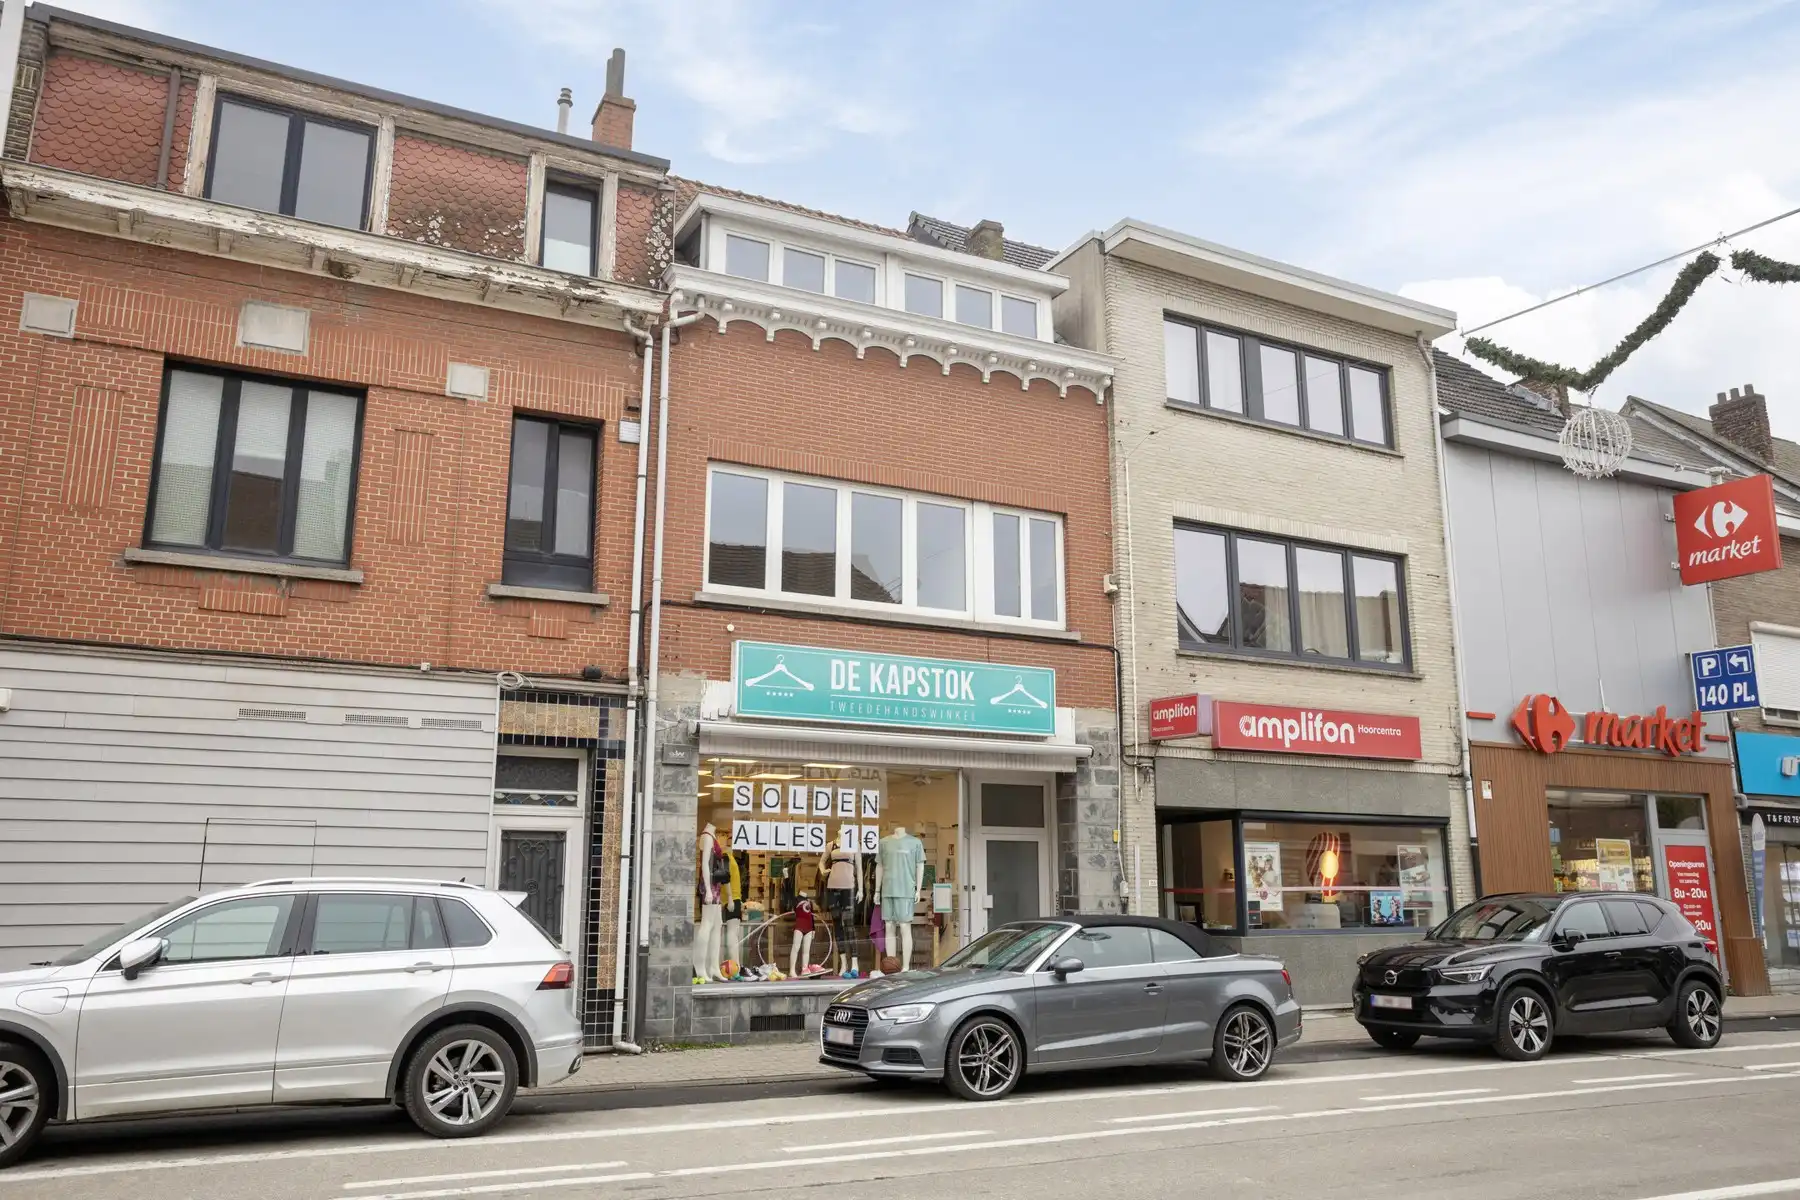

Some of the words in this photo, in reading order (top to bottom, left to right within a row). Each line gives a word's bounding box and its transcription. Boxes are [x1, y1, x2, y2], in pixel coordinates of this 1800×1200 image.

[1688, 534, 1762, 567] market
[830, 658, 861, 692] DE
[869, 661, 976, 701] KAPSTOK
[1701, 657, 1717, 676] P
[1699, 683, 1729, 706] 140
[1732, 681, 1756, 704] PL.
[829, 700, 977, 722] TWEEDEHANDSWINKEL
[1152, 703, 1196, 722] amplifon
[1238, 711, 1355, 748] amplifon
[1357, 723, 1402, 737] Hoorcentra
[1583, 704, 1707, 757] market
[735, 785, 878, 815] SOLDEN
[1766, 814, 1771, 822] T
[1778, 814, 1783, 823] F
[733, 824, 824, 851] ALLES
[1674, 887, 1686, 899] 8u
[1691, 887, 1708, 899] 20u
